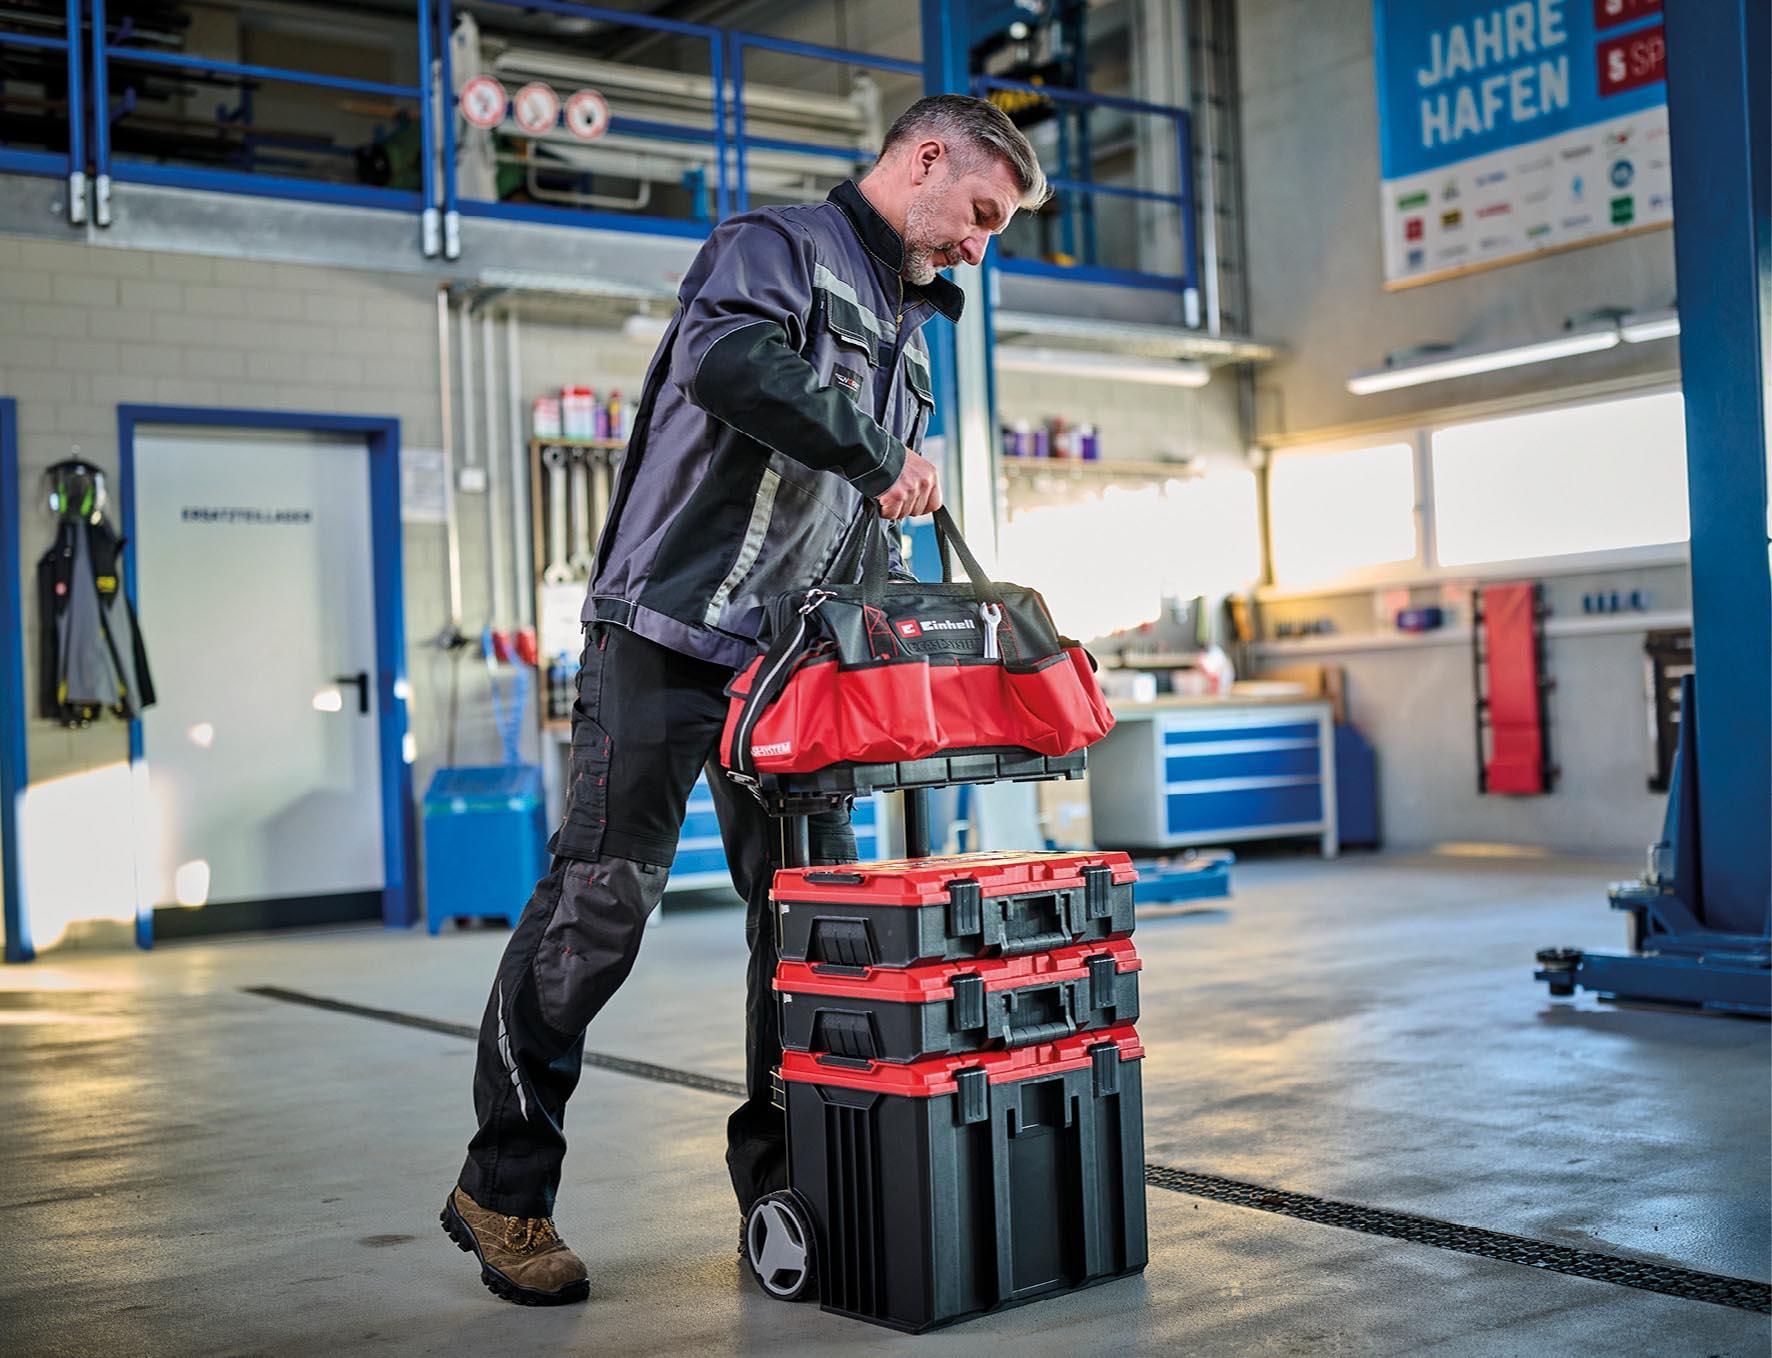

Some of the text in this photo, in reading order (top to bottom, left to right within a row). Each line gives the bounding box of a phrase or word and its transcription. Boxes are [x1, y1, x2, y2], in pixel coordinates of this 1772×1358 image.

[1417, 0, 1567, 87] JAHRE
[1420, 55, 1570, 147] HAFEN
[920, 619, 975, 632] Einhell
